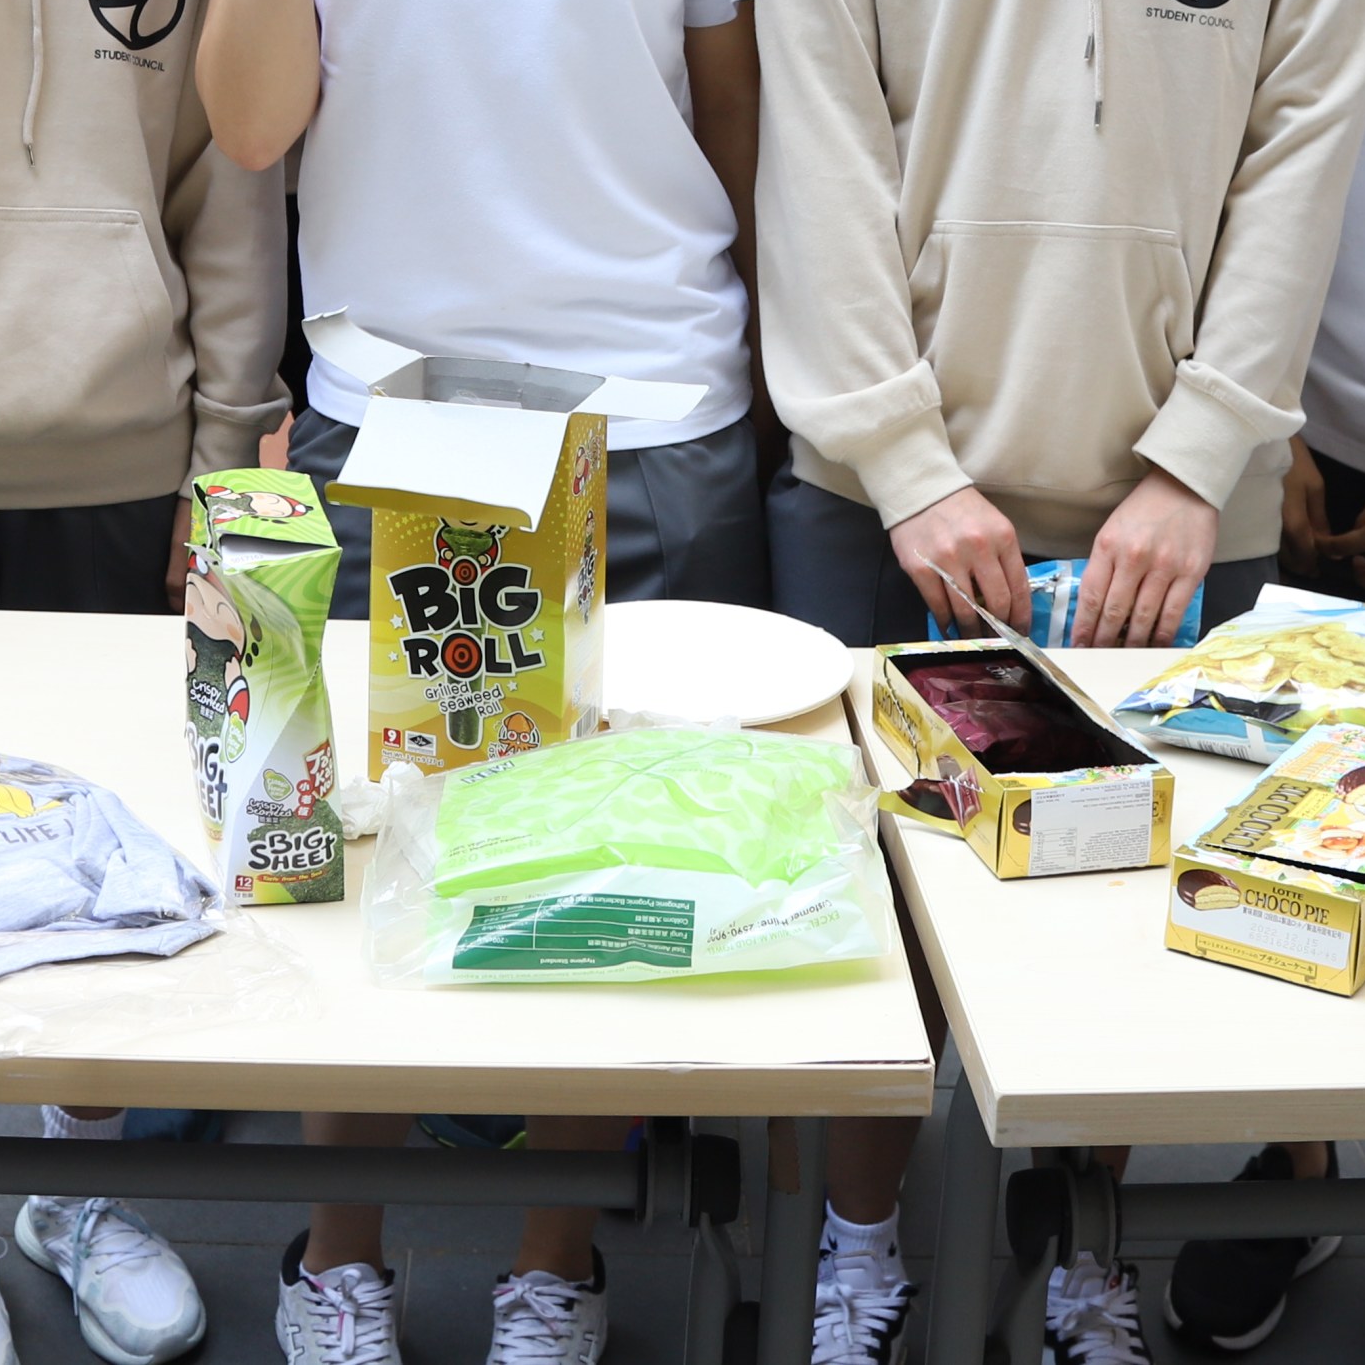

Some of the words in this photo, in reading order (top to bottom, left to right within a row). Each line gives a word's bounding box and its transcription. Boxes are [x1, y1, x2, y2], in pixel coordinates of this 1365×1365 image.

[1146, 7, 1197, 24] STUDENT
[1198, 14, 1236, 31] COUNCIL
[403, 632, 543, 678] ROLL
[192, 679, 222, 700] Crispy
[425, 682, 470, 699] Grilled
[440, 685, 503, 713] Seaweed
[478, 701, 501, 717] Roll
[388, 730, 397, 742] 9
[248, 798, 284, 812] Crispy
[1221, 802, 1289, 849] CHOCO
[1266, 782, 1312, 806] PIE
[268, 829, 322, 855] BIG
[237, 877, 253, 887] 12
[1272, 886, 1304, 900] LOTTE
[594, 896, 626, 906] Bacterium
[626, 897, 655, 907] Pyogenic
[656, 900, 690, 910] Pathogenic
[1245, 889, 1301, 917] CHOCO
[1304, 904, 1330, 925] PIE
[789, 899, 833, 922] Customer
[662, 916, 689, 925] Coliform
[669, 930, 688, 939] Fungi
[671, 946, 687, 954] Total
[540, 957, 569, 965] Standard
[569, 956, 596, 965] Hygiene
